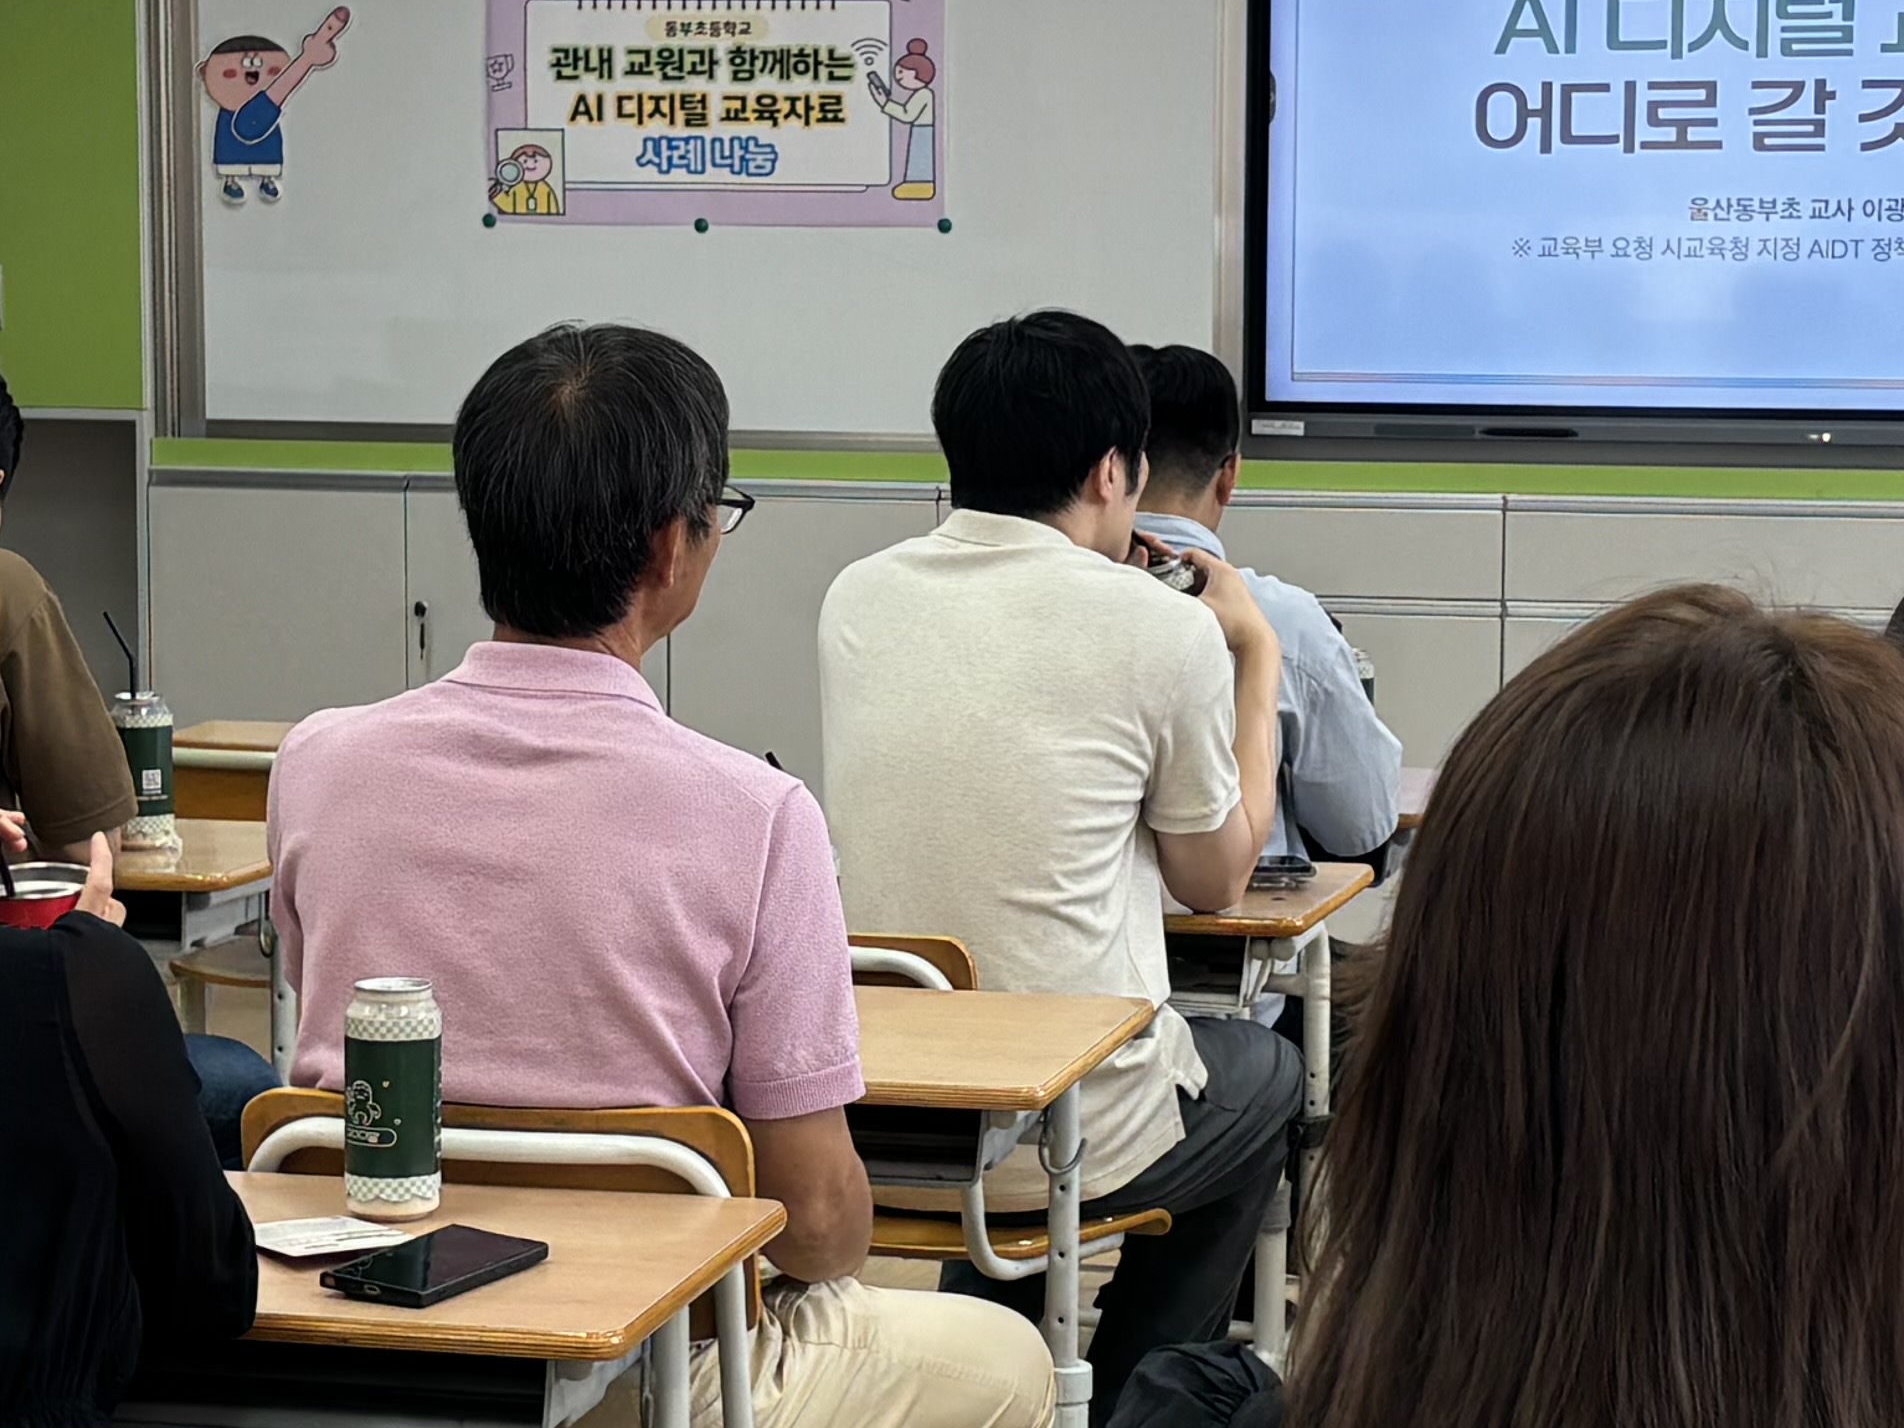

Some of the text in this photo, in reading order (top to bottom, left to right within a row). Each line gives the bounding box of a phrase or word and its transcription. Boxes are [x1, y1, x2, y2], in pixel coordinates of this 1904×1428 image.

[664, 20, 752, 38] 동부초등학교
[550, 45, 854, 83] 관내 교원과 함께하는
[569, 92, 847, 127] AI 디지털 교육자료
[1475, 79, 1723, 154] 어디로
[1748, 78, 1835, 153] 갈
[637, 137, 778, 177] 사례 나눔
[1688, 195, 1802, 223] 울산동부초
[1809, 196, 1854, 222] 교사
[1537, 236, 1604, 261] 교육부
[1611, 236, 1653, 261] 요청
[1661, 236, 1750, 262] 시교육청
[1757, 236, 1801, 261] 지정
[1807, 238, 1864, 260] AIDT
